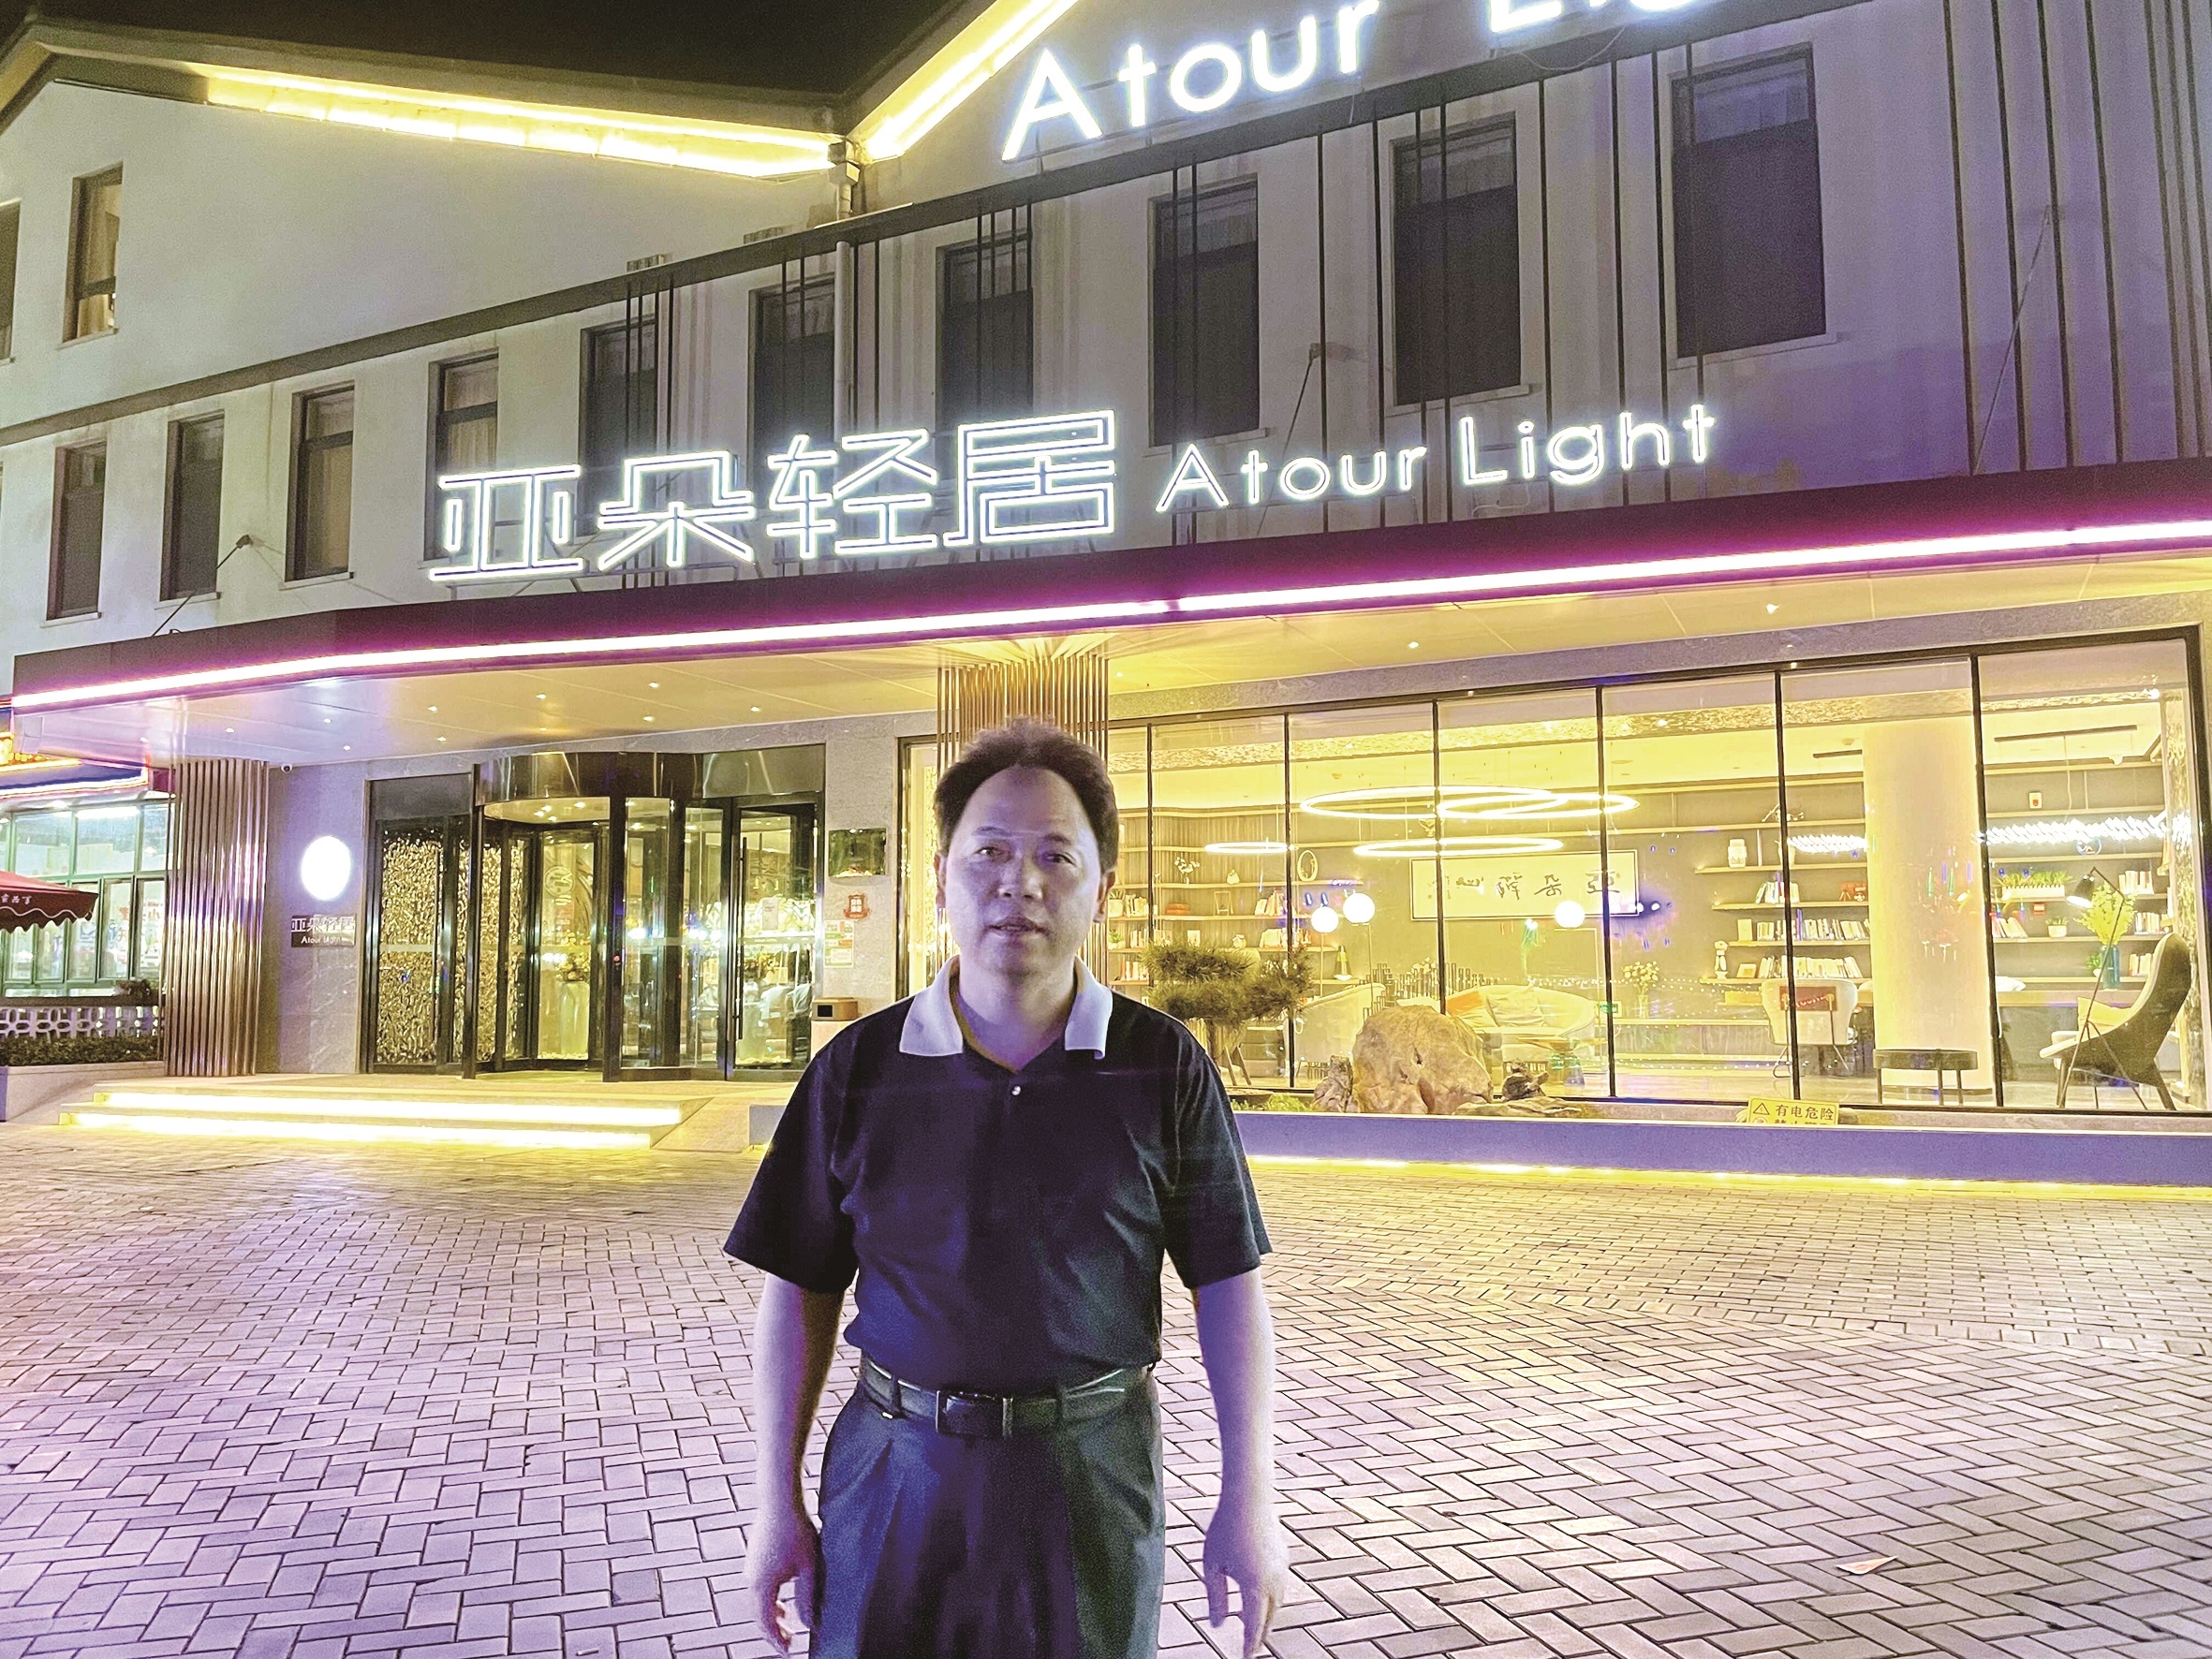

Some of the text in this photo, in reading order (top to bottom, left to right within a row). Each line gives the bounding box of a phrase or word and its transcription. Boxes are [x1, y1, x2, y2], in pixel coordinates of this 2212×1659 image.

[1000, 0, 1380, 161] Atour
[429, 409, 1116, 581] 亚朵轻居
[1155, 404, 1716, 513] Atour Light
[1776, 1105, 1834, 1121] 有电危险
